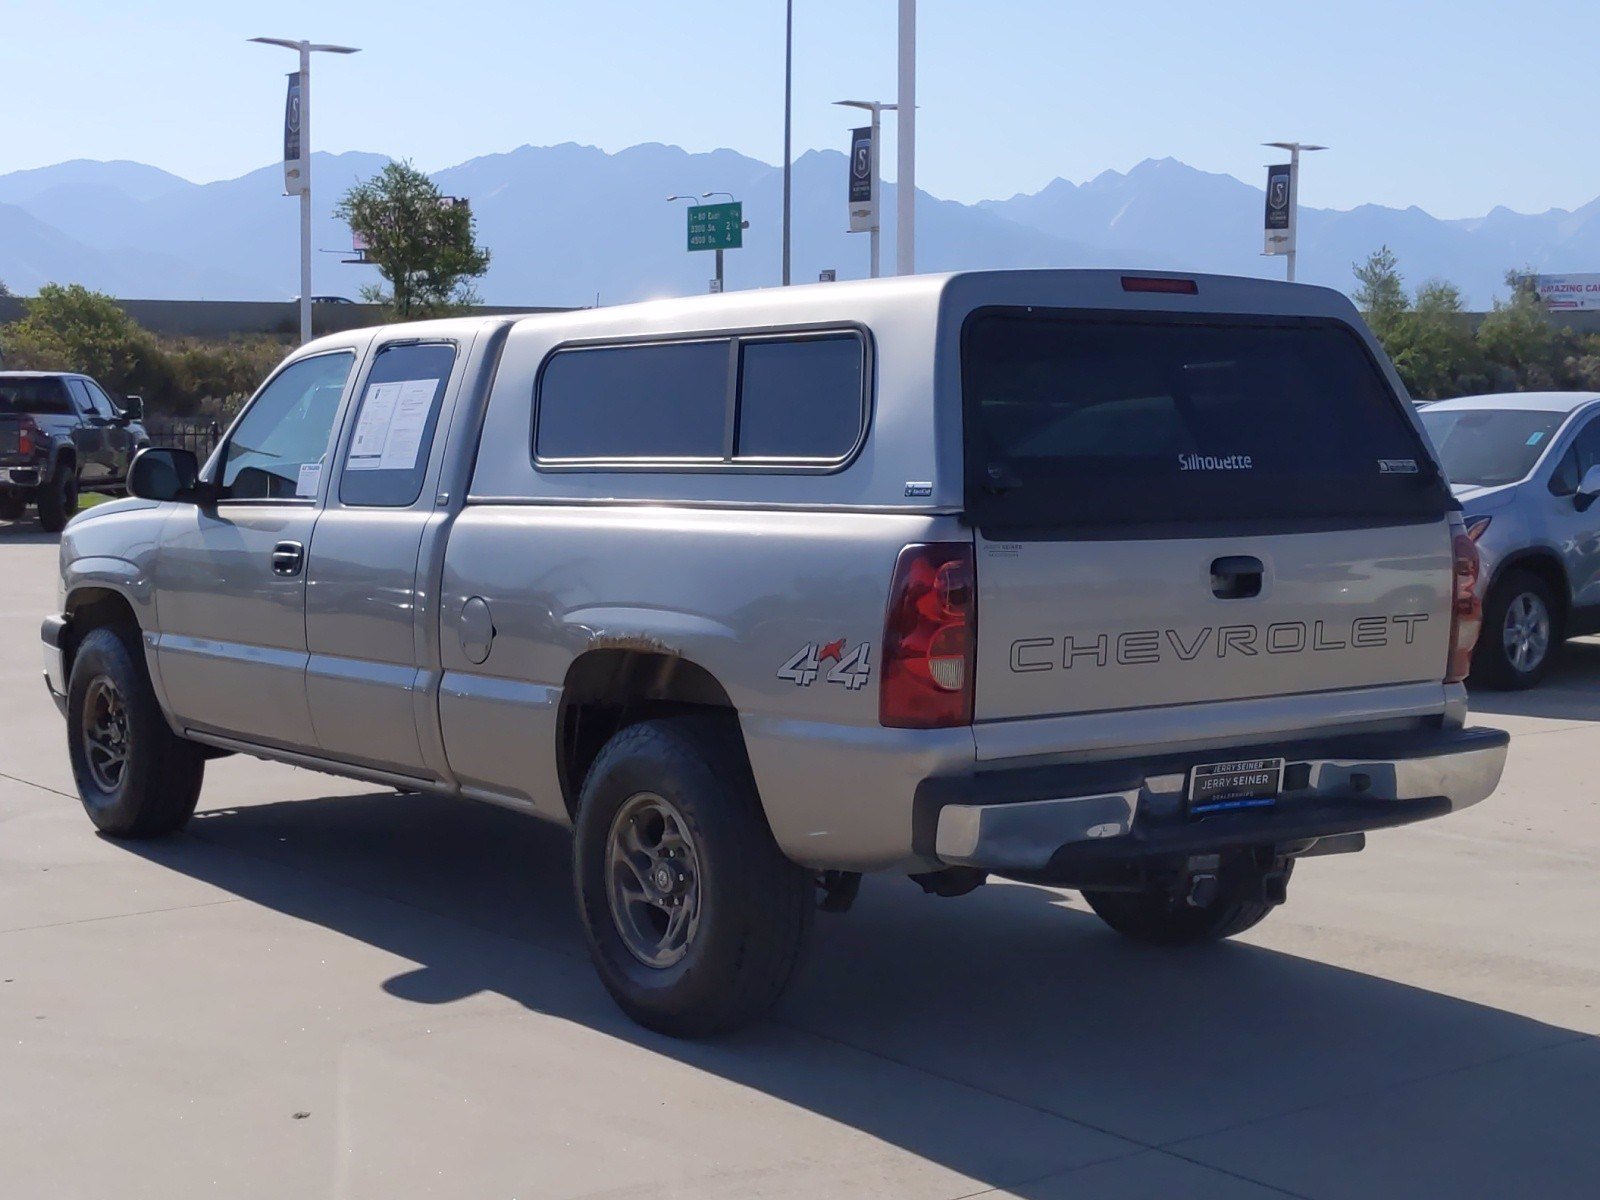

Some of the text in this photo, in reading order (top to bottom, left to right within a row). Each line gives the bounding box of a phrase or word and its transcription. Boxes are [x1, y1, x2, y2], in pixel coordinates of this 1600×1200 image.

[1178, 453, 1253, 471] Silhouette
[1010, 614, 1429, 673] CHEVROLET
[1213, 761, 1264, 774] JERRY SEINER
[1201, 774, 1269, 790] JERRY SEINER
